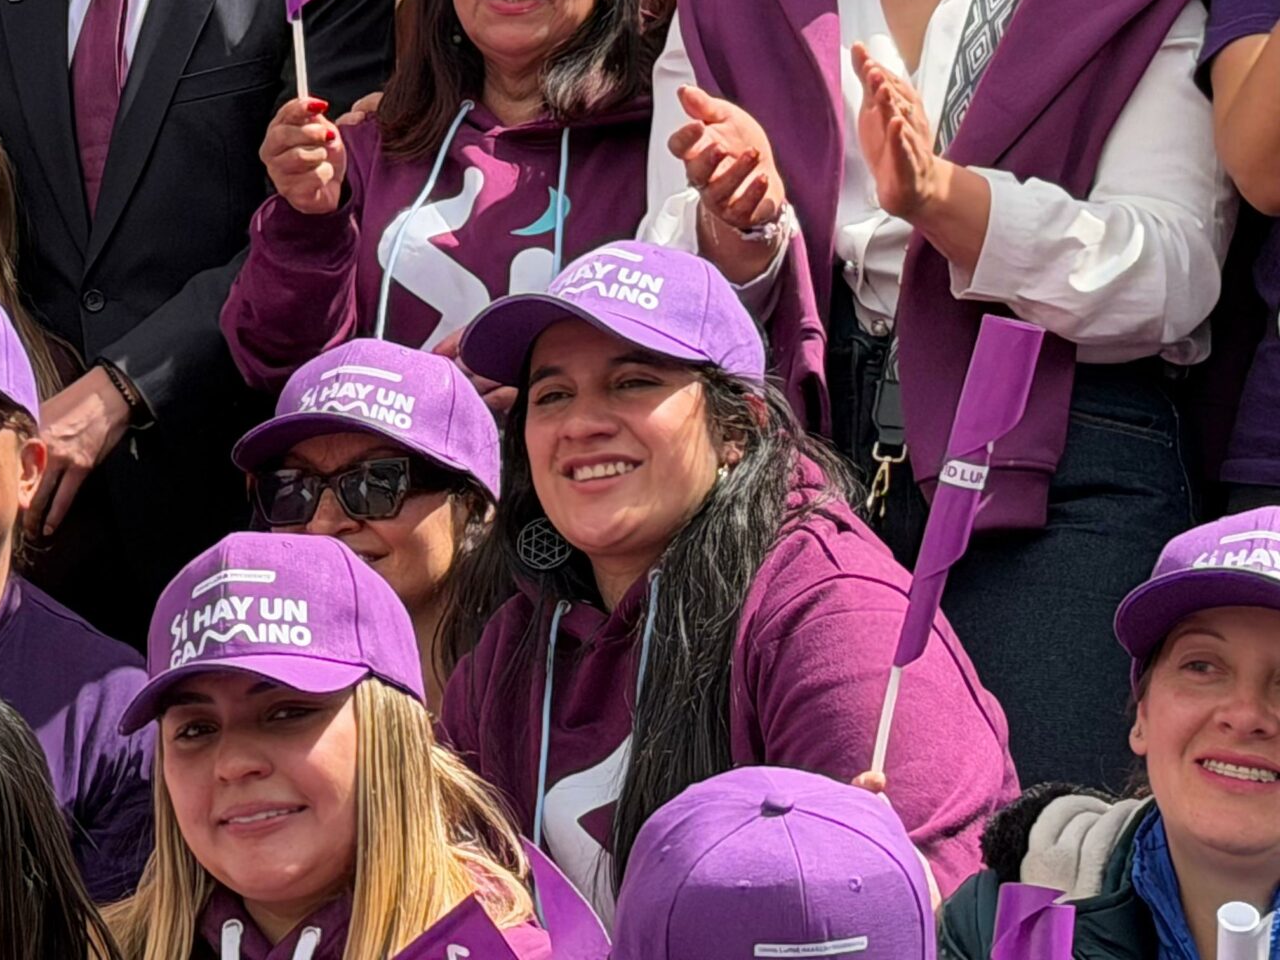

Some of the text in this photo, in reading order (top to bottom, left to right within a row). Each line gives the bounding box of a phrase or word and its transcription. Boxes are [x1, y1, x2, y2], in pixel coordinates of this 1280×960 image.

[617, 267, 665, 294] UN
[319, 382, 375, 402] HAY
[376, 387, 415, 414] UN
[193, 596, 254, 633] HAY
[260, 597, 308, 623] UN
